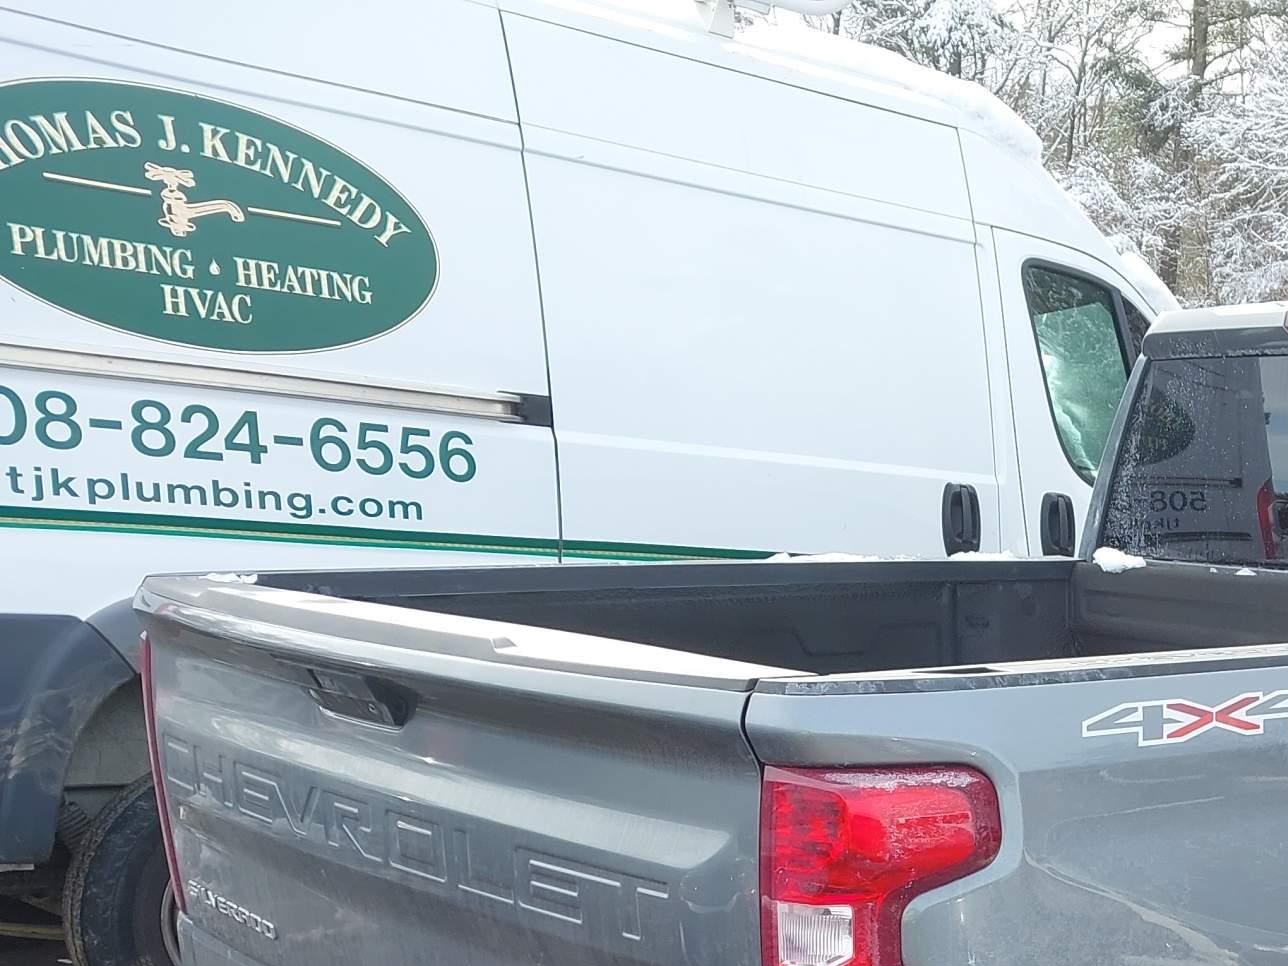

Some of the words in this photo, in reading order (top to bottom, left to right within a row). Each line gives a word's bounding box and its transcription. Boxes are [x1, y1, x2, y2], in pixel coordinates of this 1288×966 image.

[158, 115, 190, 154] J.
[200, 122, 411, 247] KENNEDY
[7, 222, 195, 279] PLUMBING
[234, 257, 373, 304] HEATING
[161, 285, 254, 325] HVAC
[0, 384, 478, 483] 08-824-6556
[5, 466, 424, 520] tjkplumbing.com
[163, 732, 670, 941] CHEVROLET
[187, 879, 278, 940] SILVERADO
